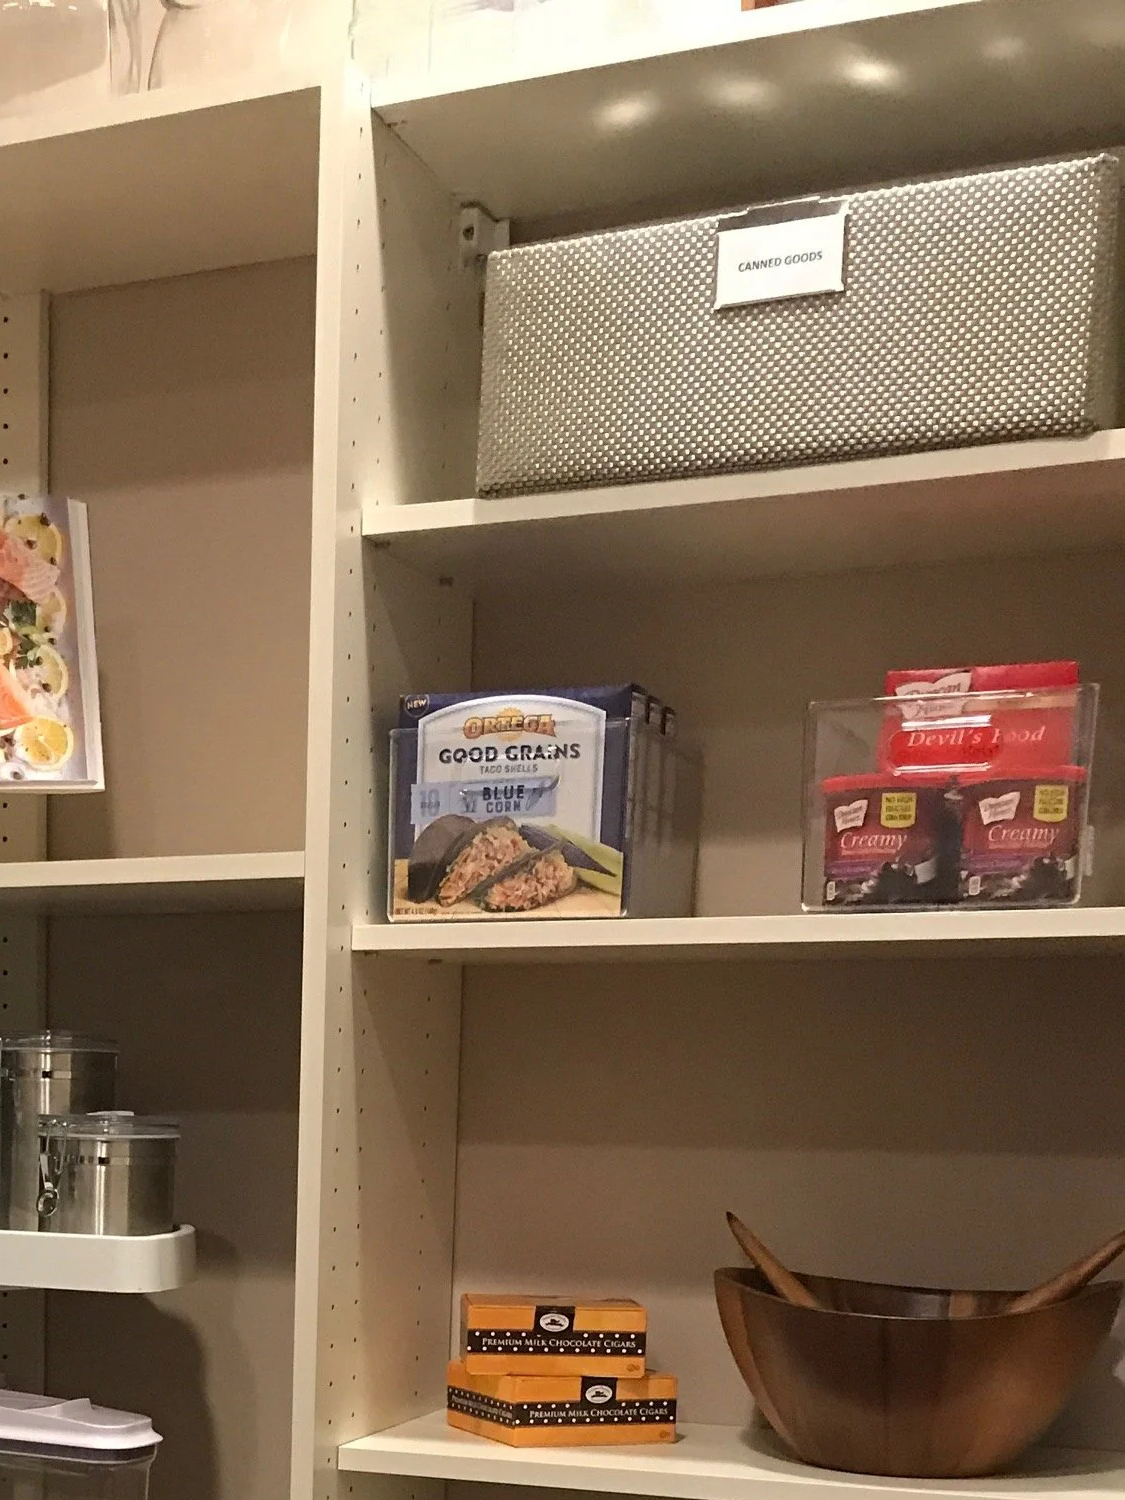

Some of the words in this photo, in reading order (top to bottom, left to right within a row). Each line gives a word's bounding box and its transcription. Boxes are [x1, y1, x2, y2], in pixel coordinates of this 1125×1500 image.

[738, 257, 782, 273] CANNED
[784, 250, 823, 266] GOODS
[406, 698, 428, 710] NEW
[463, 713, 557, 740] ORTEGA
[907, 728, 983, 748] Devil's
[439, 746, 499, 764] GOOD
[504, 743, 581, 761] GRAINS
[479, 765, 502, 774] TACO
[504, 764, 538, 773] SHELLS
[482, 785, 526, 801] BLUE
[486, 800, 521, 814] CORN
[840, 832, 908, 851] Creamy
[988, 825, 1060, 845] Creamy
[482, 1337, 522, 1347] PREMIUM
[524, 1338, 547, 1347] MILK
[548, 1338, 602, 1348] CHOCOLATE
[603, 1339, 636, 1349] CIGARS
[529, 1409, 567, 1419] PREMIUM
[568, 1408, 589, 1418] MILK
[590, 1407, 638, 1418] CHOCOLATE
[639, 1405, 668, 1417] CIGARS
